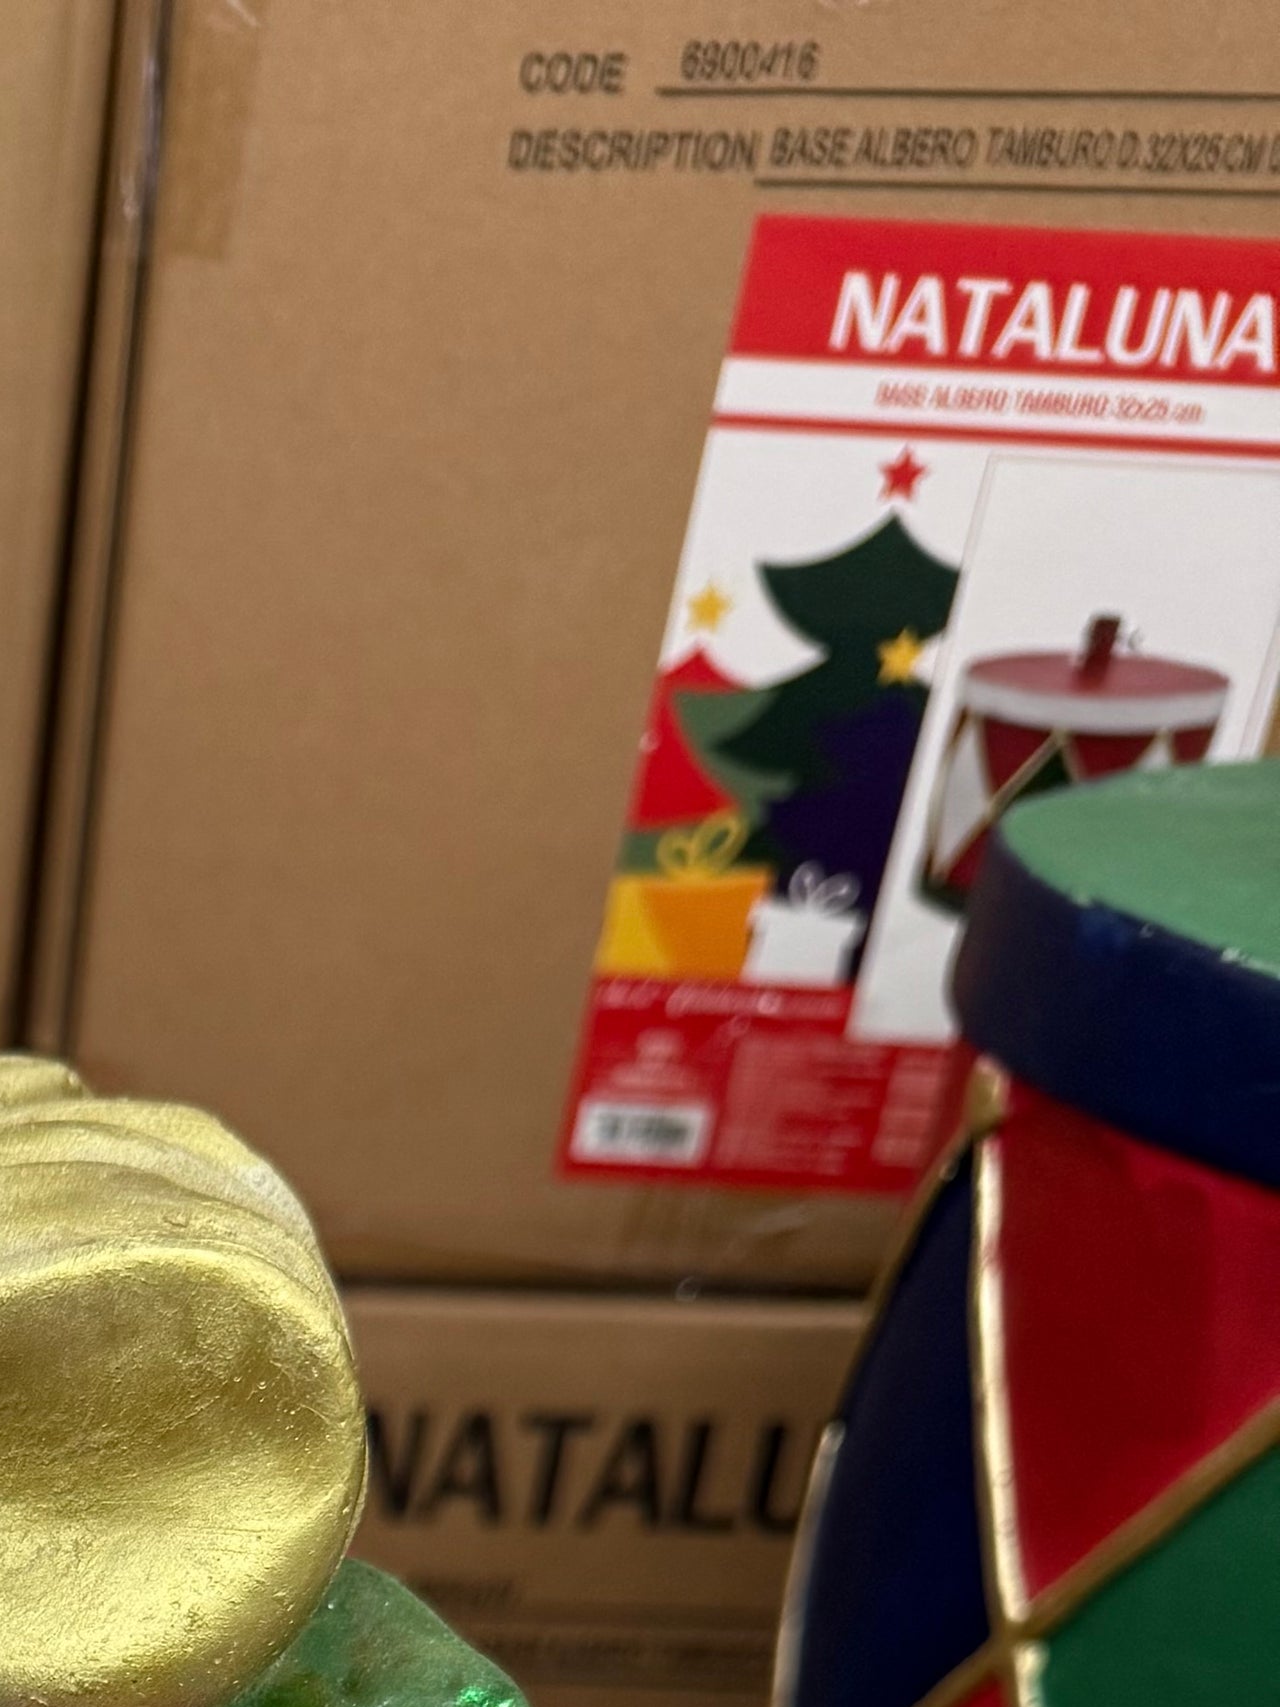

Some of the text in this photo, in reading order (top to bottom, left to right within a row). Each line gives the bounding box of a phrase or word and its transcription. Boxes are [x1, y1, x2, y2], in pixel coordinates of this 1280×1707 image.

[520, 53, 626, 94] CODE
[509, 128, 757, 173] DESCRIPTION
[770, 126, 854, 168] BASE
[855, 127, 977, 169] ALBERO
[985, 127, 1114, 173] TAMBURO
[830, 271, 1278, 372] NATALUNA
